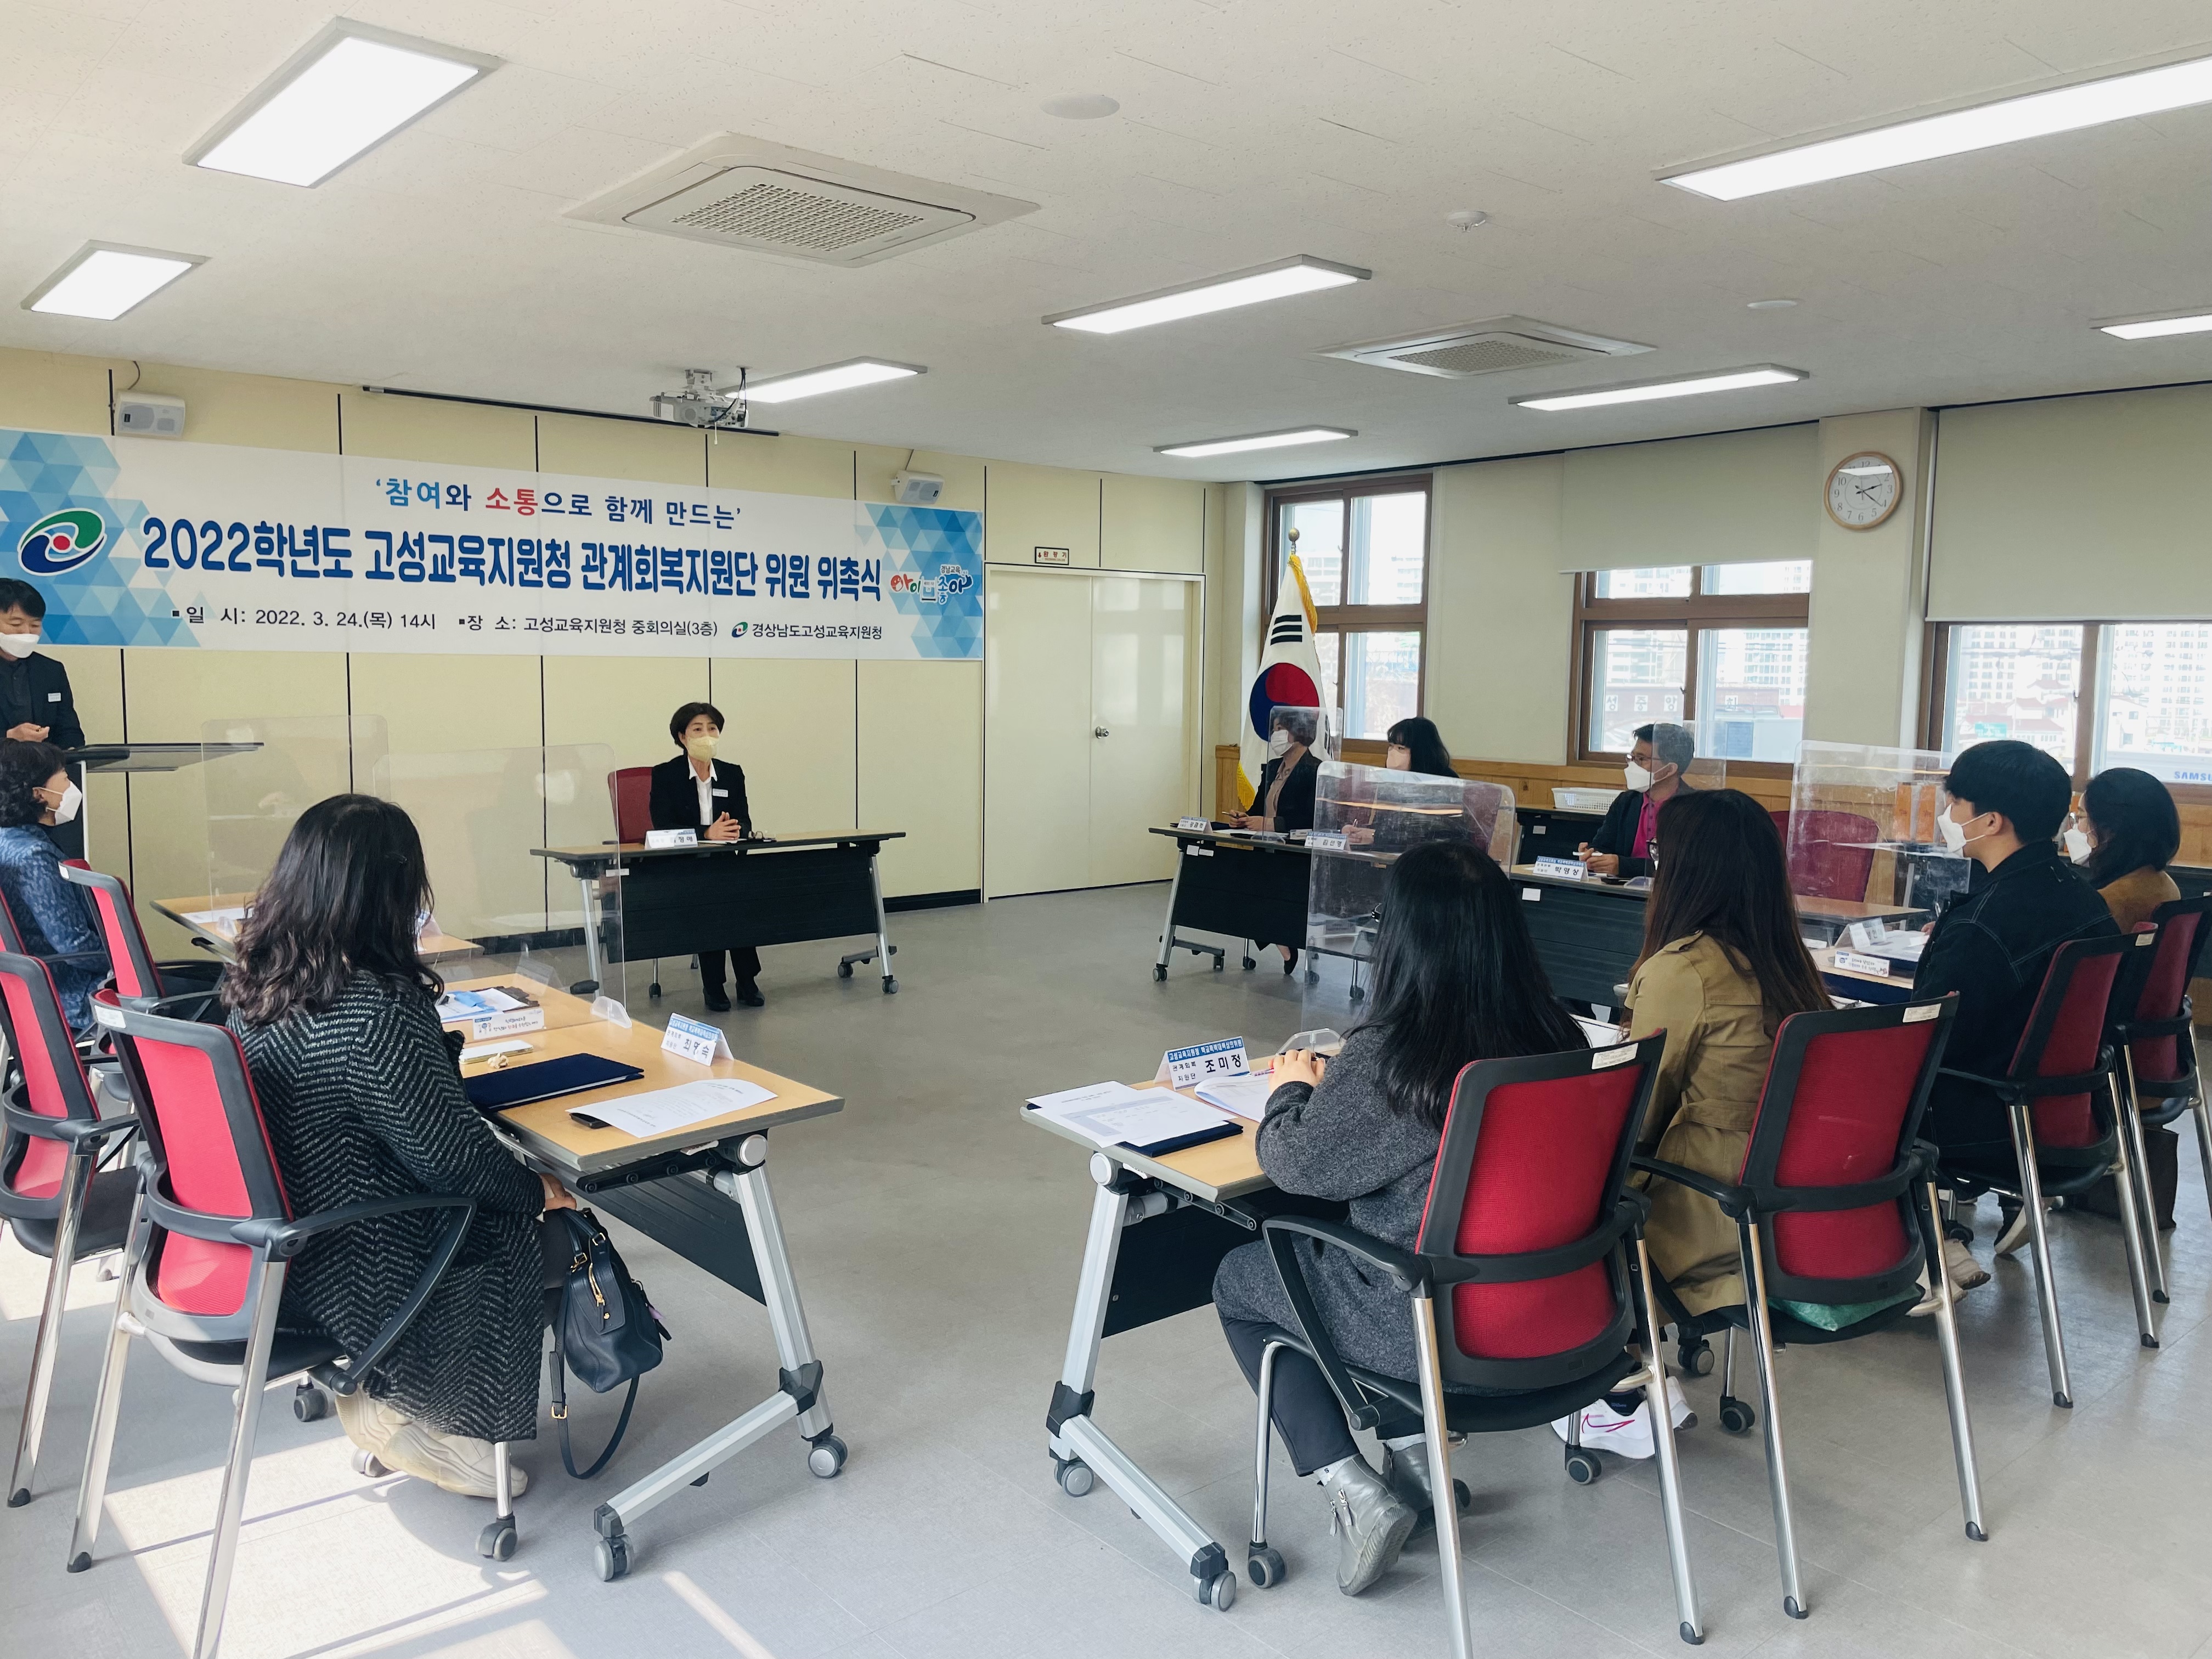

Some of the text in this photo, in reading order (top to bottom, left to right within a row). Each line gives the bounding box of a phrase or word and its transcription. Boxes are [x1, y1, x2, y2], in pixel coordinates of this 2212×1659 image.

[1838, 477, 1847, 486] 10
[1887, 484, 1893, 494] 3
[1834, 490, 1839, 498] 9
[486, 488, 592, 516] 소통으로
[605, 495, 652, 524] 함께
[1837, 503, 1843, 511] 8
[1847, 511, 1852, 520] 7
[1858, 512, 1864, 521] 6
[1871, 508, 1877, 517] 5
[143, 517, 881, 601] 2022학년도 고성교육지원청 관계회복지원단 위원 위촉식
[941, 566, 961, 574] 경남교육
[256, 610, 306, 626] 2022.
[313, 611, 329, 627] 3.
[336, 611, 392, 629] 24.(목)
[400, 614, 436, 630] 14시
[524, 617, 626, 634] 고성교육지원청
[631, 620, 718, 637] 중회의실(3층)
[752, 623, 882, 640] 경상남도고성교육지원청
[1205, 1053, 1241, 1073] 조미정
[1178, 1073, 1196, 1082] 지원단
